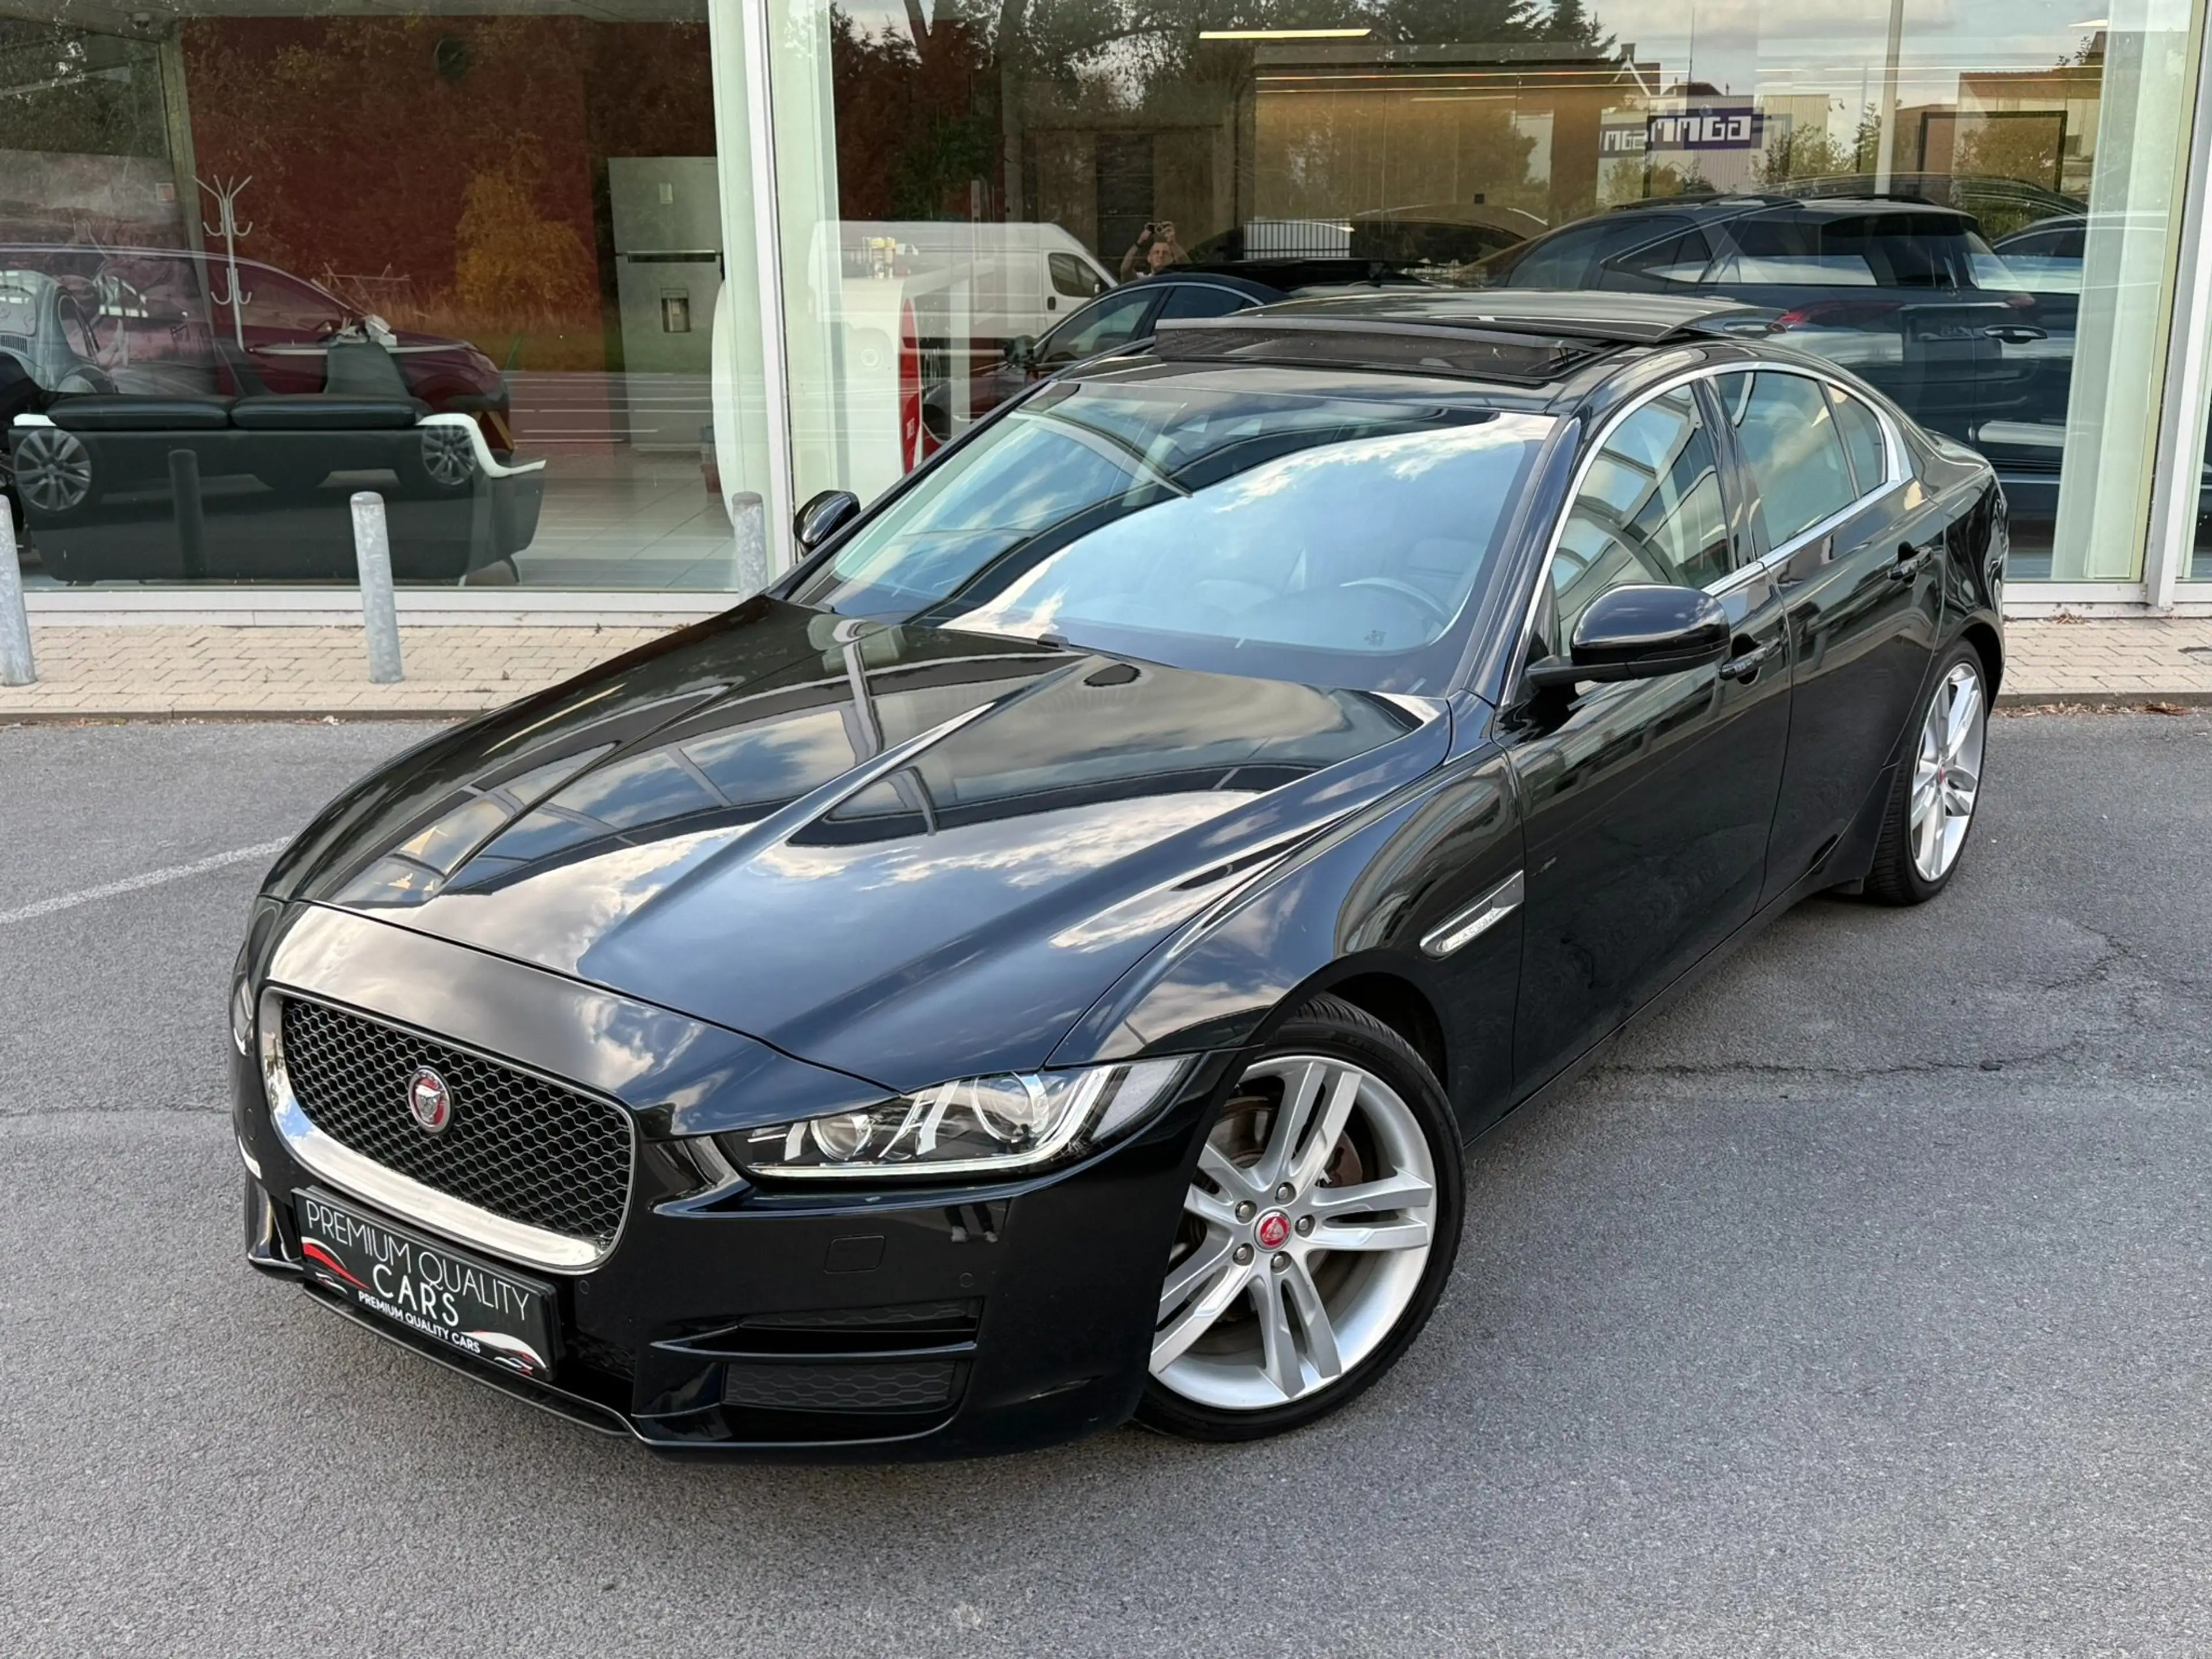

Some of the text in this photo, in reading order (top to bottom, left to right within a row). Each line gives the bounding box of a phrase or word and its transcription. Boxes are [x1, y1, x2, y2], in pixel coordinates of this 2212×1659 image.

[306, 1199, 529, 1321] PREMIUM QUALITY
[358, 1290, 481, 1354] PREMIUM QUALITY CARS
[372, 1263, 459, 1327] CARS
